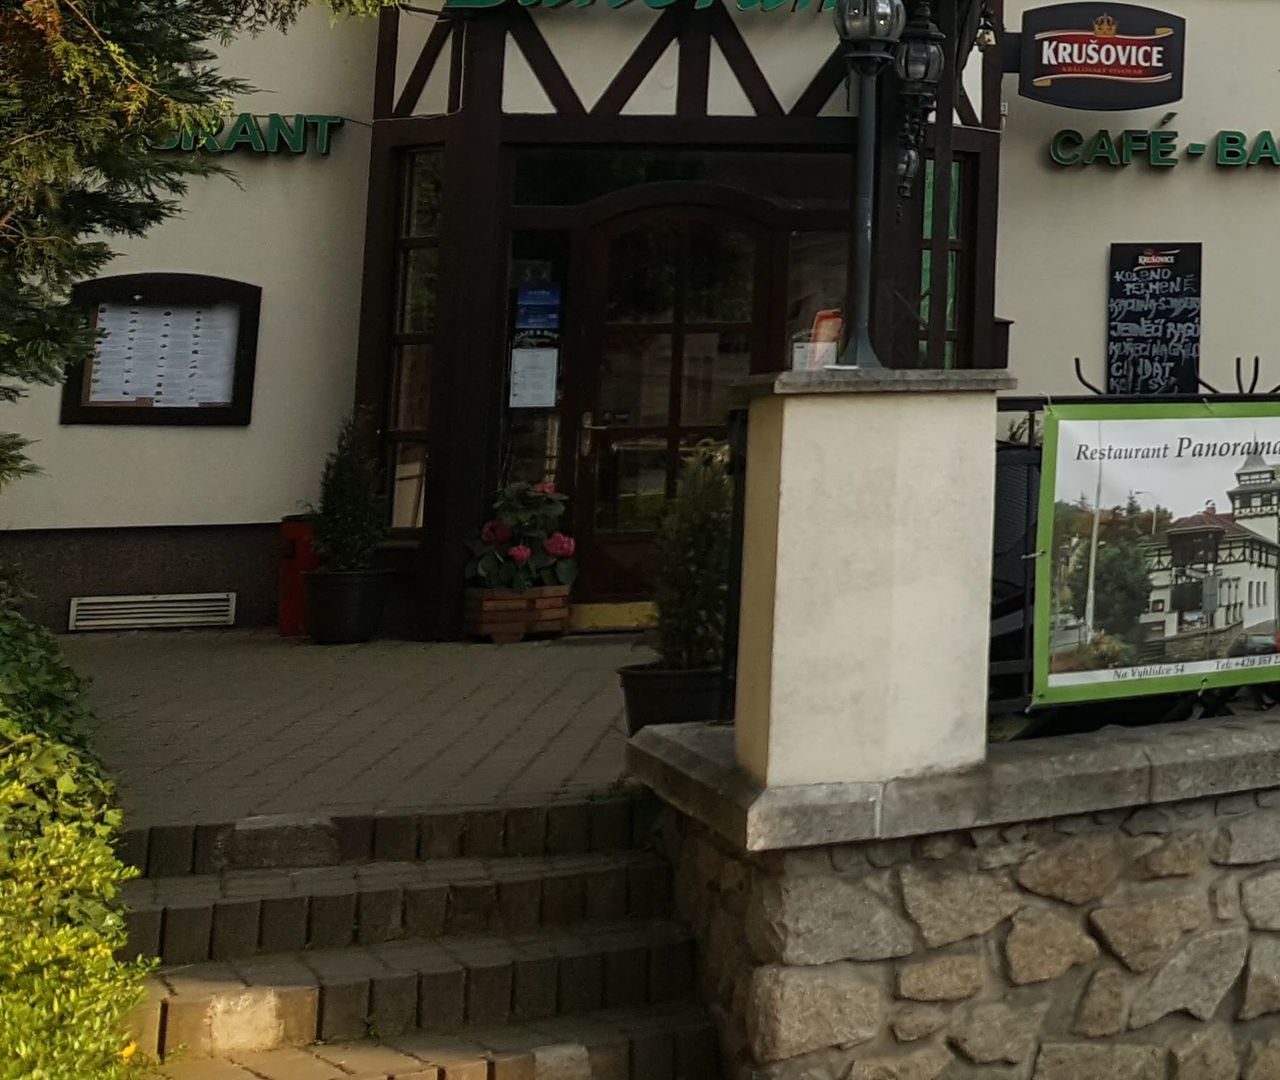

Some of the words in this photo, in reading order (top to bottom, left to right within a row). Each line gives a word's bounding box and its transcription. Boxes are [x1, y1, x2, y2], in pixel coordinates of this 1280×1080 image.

[1042, 39, 1164, 67] KRUŠOVICE
[1050, 112, 1180, 166] CAFÉ
[1075, 443, 1170, 461] Restaurant
